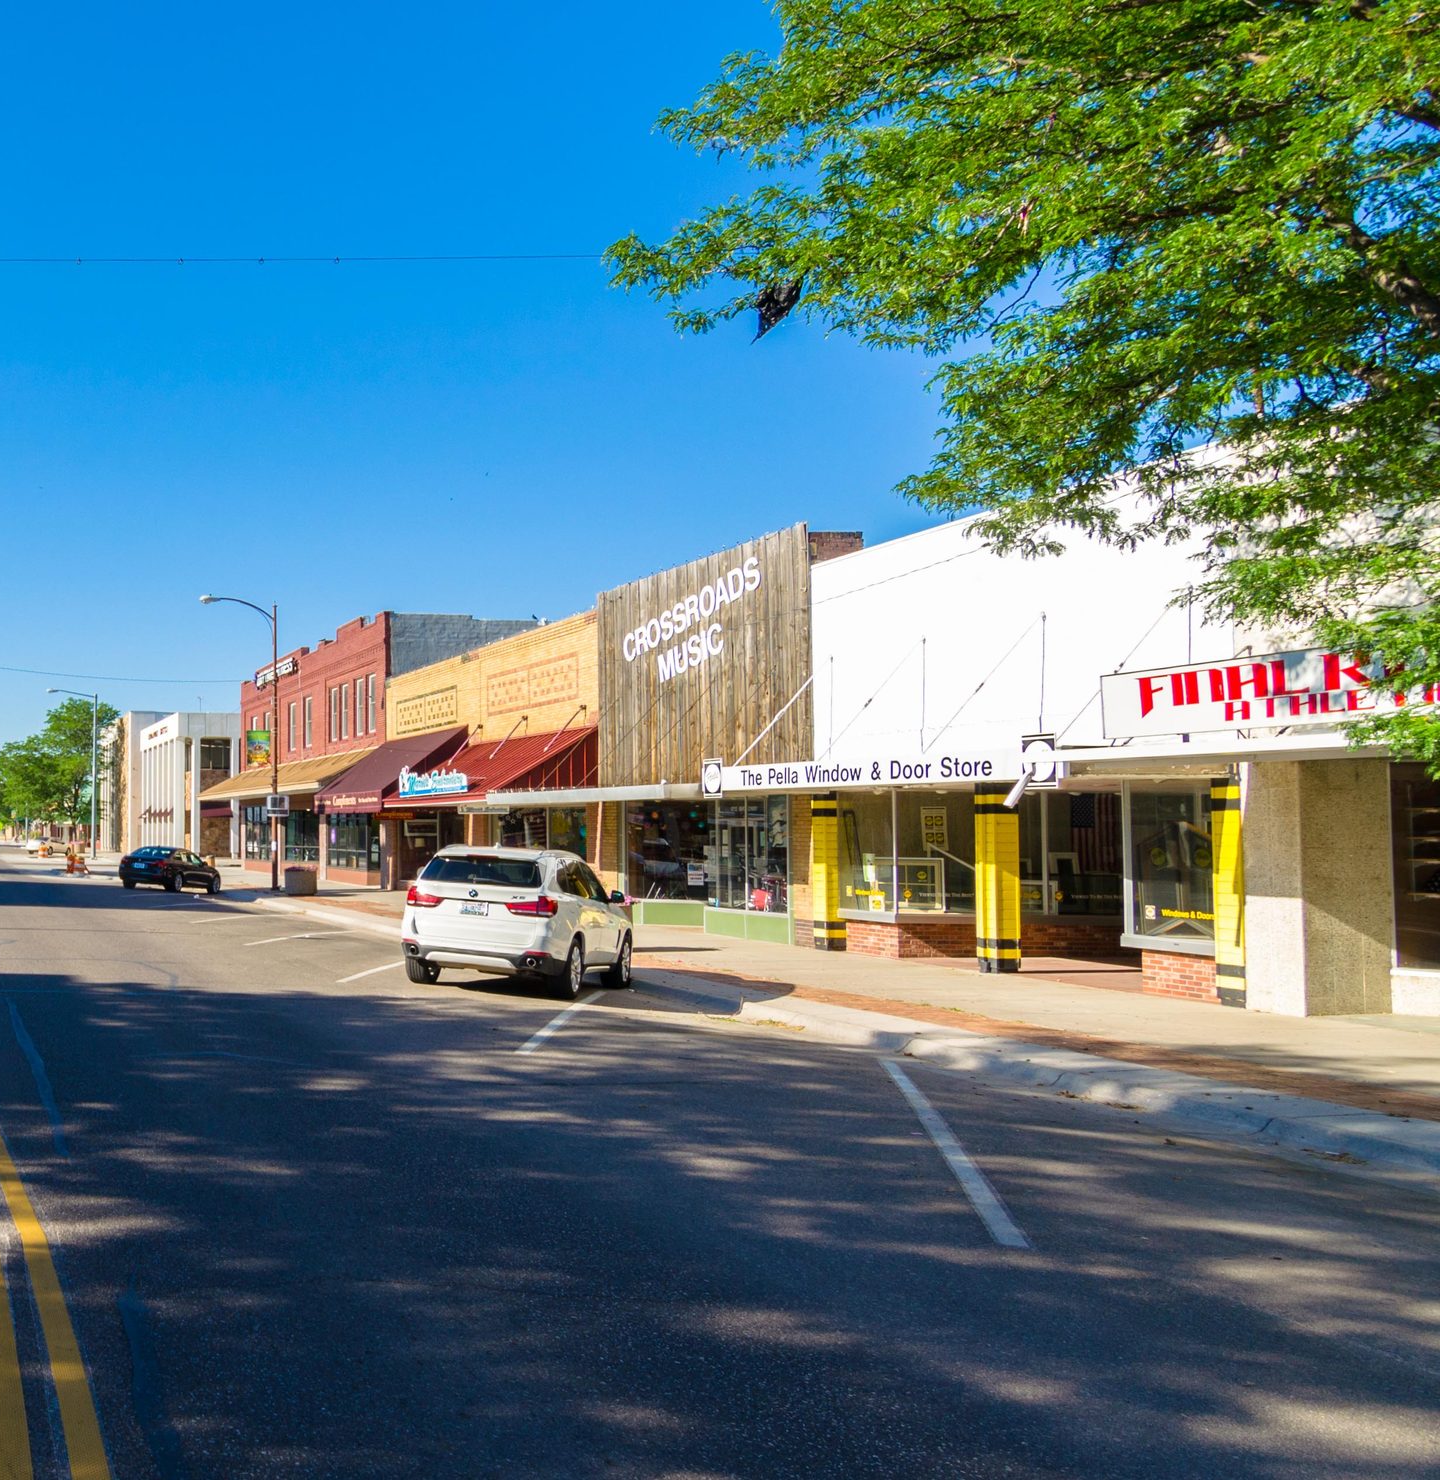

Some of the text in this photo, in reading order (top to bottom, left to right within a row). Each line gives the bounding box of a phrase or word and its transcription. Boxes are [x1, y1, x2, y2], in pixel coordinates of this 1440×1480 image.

[623, 557, 761, 662] CROSSROADS
[657, 623, 724, 683] MUSIC
[1134, 659, 1310, 718] FINAL
[741, 756, 993, 786] The Pella Window & Door Store
[1161, 908, 1189, 919] Windows
[1190, 910, 1196, 919] &
